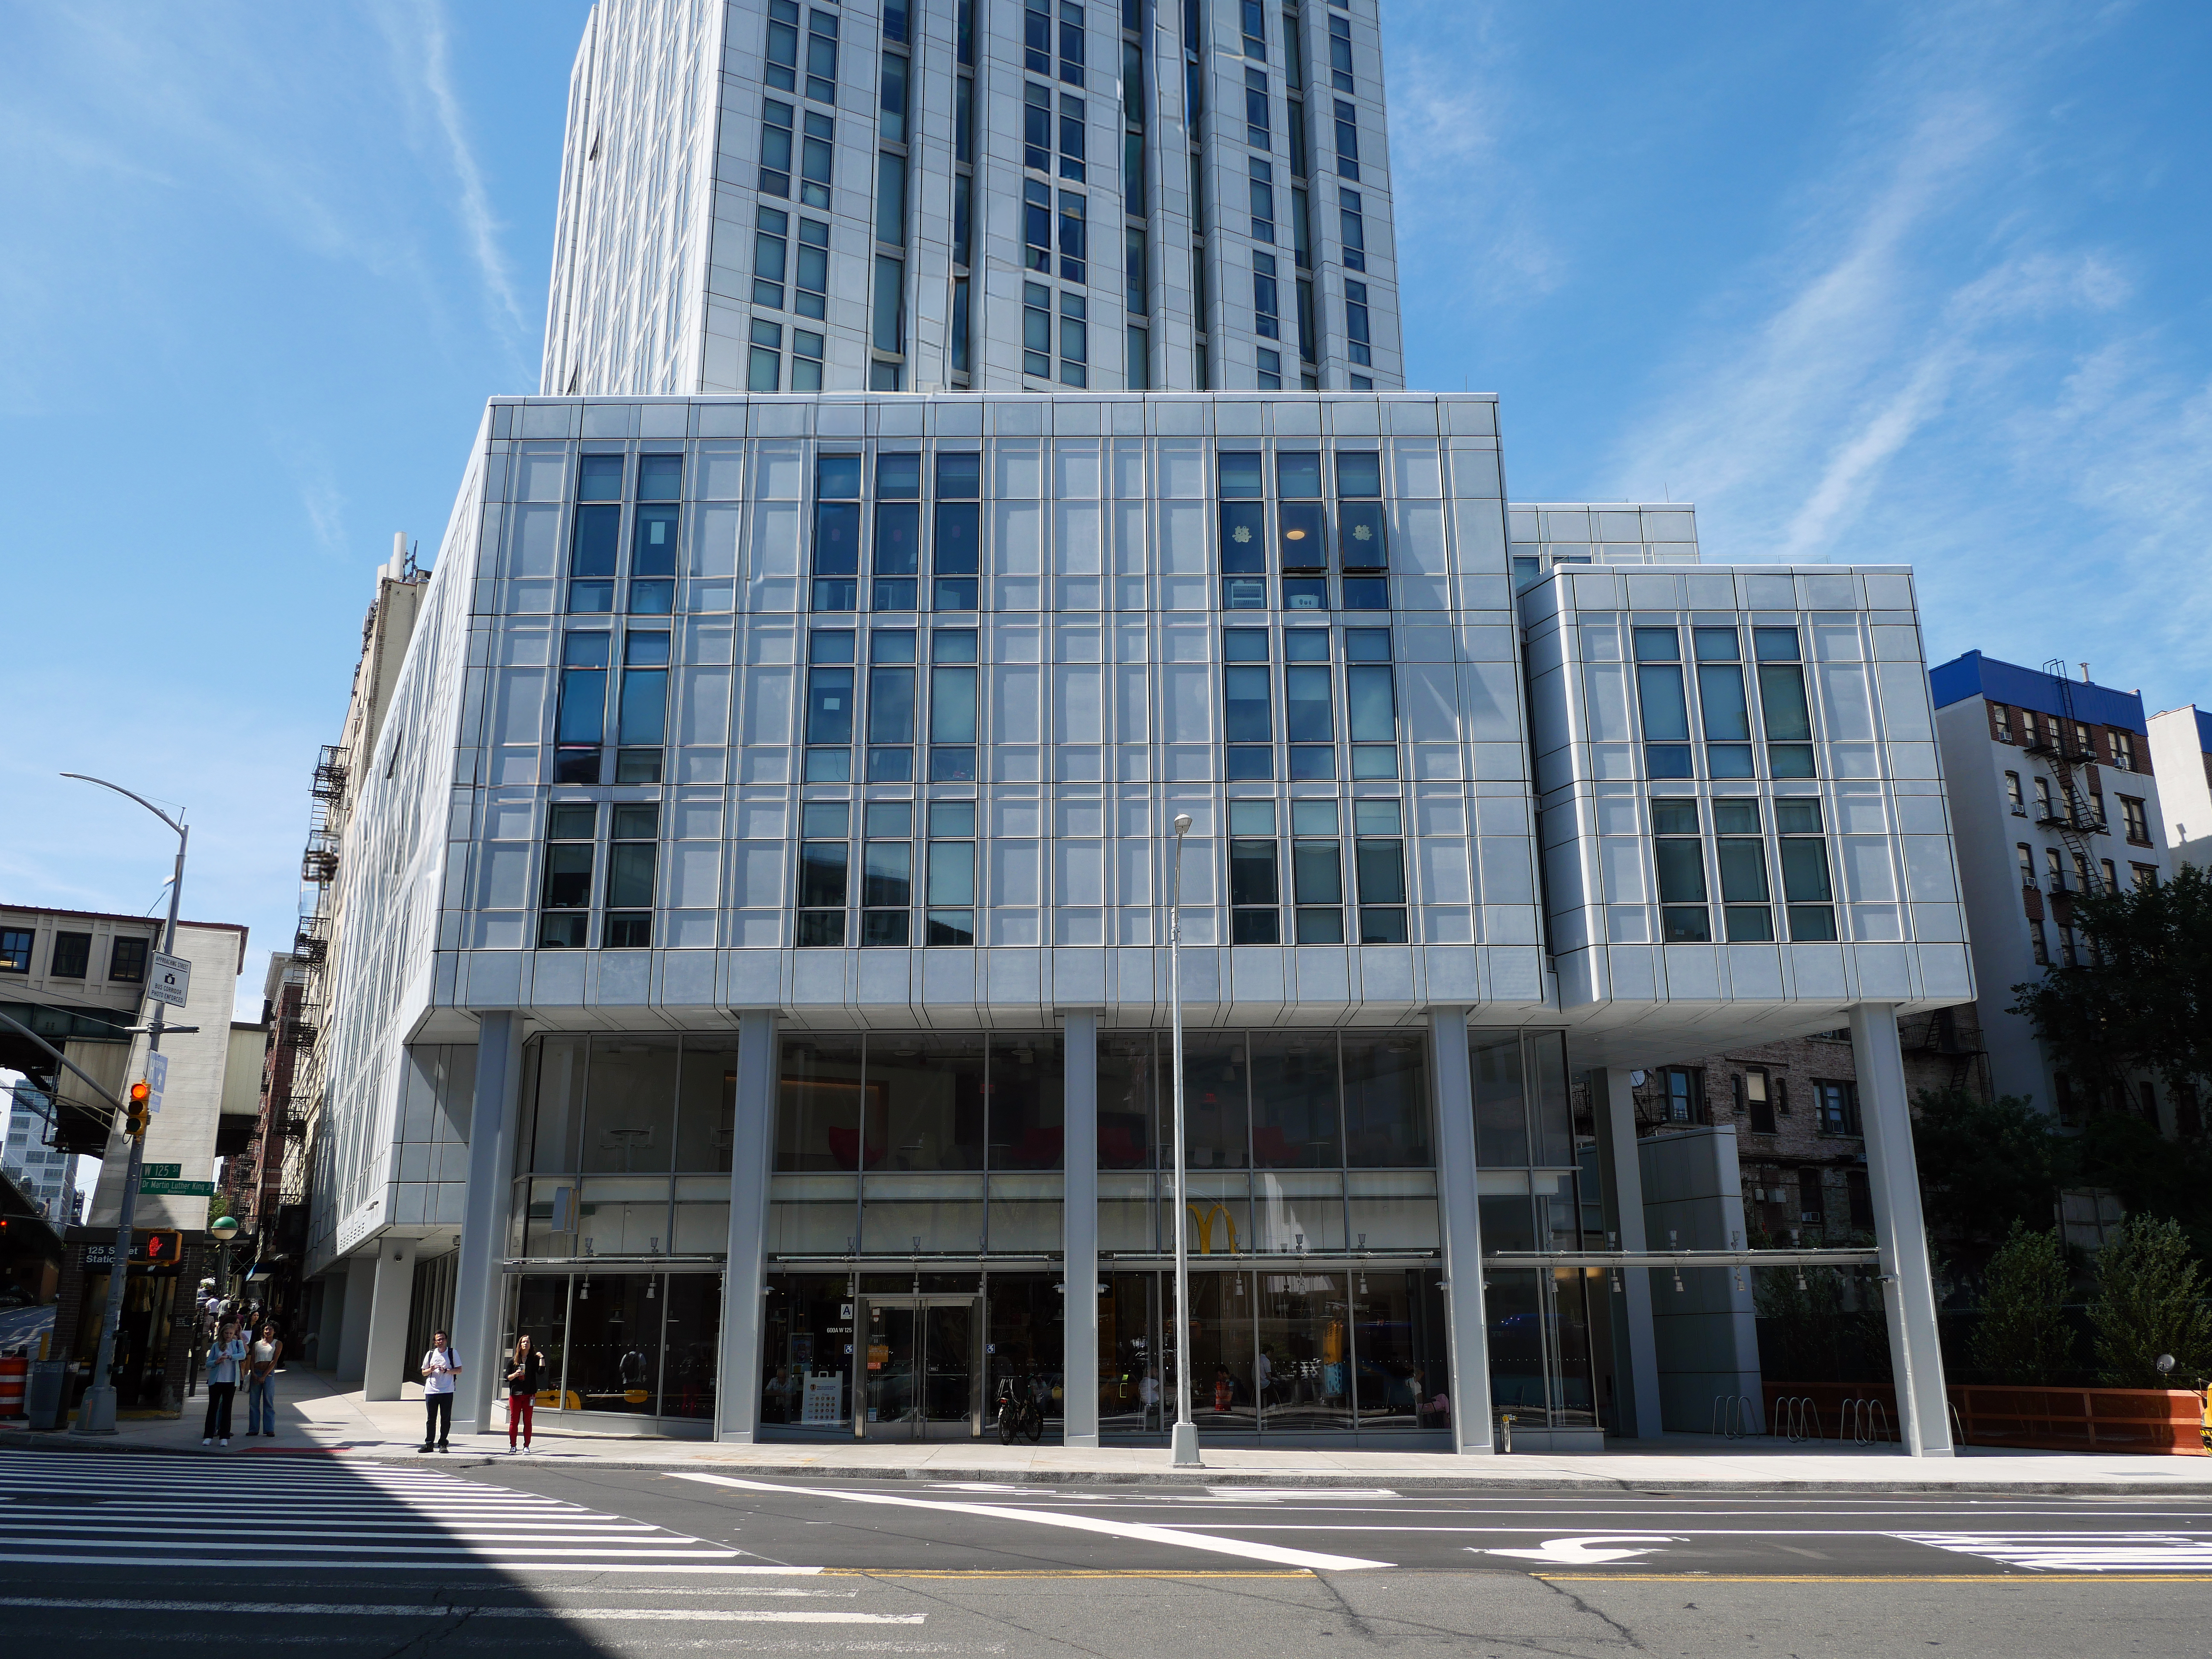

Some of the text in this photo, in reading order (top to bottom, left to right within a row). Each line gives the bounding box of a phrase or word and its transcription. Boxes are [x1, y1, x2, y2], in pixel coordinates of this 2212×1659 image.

[156, 956, 177, 967] APPROACHING
[163, 986, 182, 995] CORRIDOR
[164, 993, 183, 1003] ENFORCED
[144, 1165, 152, 1176] W
[155, 1165, 169, 1176] 125
[192, 1182, 204, 1192] King
[843, 1306, 850, 1315] A
